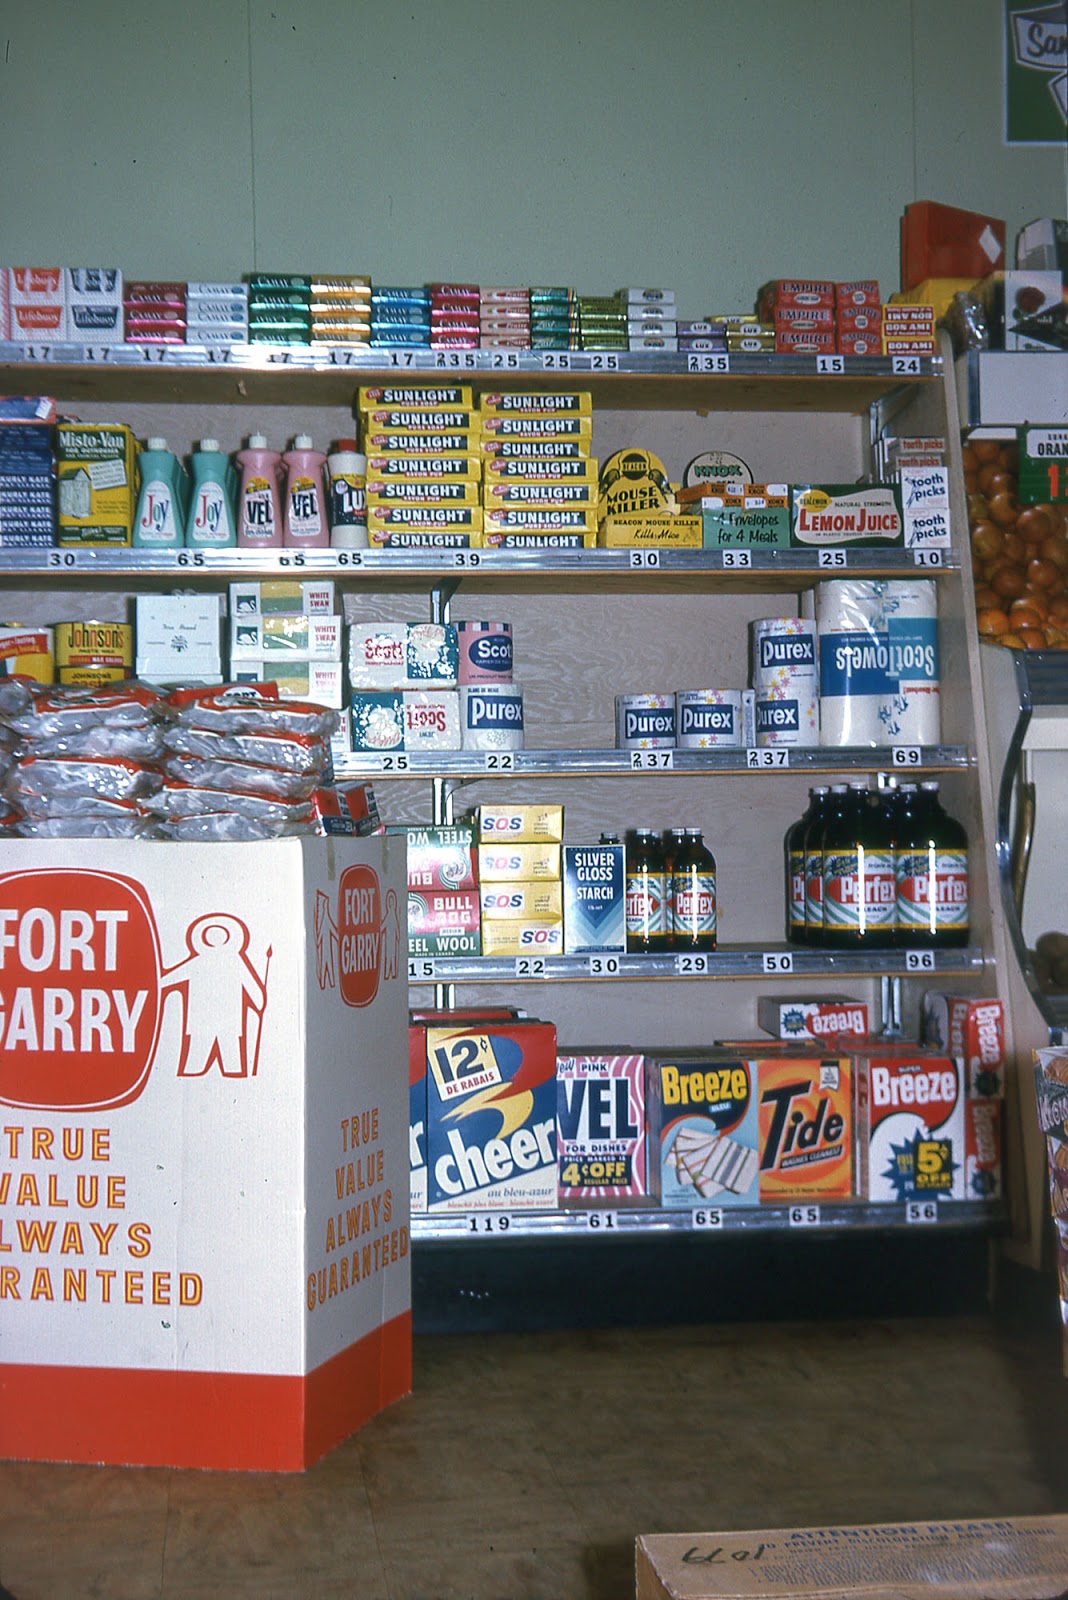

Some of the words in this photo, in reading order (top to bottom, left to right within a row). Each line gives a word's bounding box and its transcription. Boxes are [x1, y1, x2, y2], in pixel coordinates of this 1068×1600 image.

[783, 283, 830, 293] EMPIRE
[778, 308, 830, 320] EMPIRE
[886, 323, 907, 331] BON
[909, 323, 931, 331] AMI
[781, 331, 832, 344] EMPIRE
[27, 345, 50, 360] 17
[888, 342, 909, 350] BON
[912, 342, 933, 350] AMI
[86, 347, 110, 361] 17
[143, 348, 165, 362] 17
[208, 350, 230, 363] 17
[267, 352, 290, 363] 17
[329, 351, 353, 365] 17
[391, 352, 414, 366] 17
[494, 354, 517, 367] 25
[545, 355, 568, 368] 25
[593, 355, 617, 369] 25
[820, 358, 842, 372] 15
[896, 360, 918, 372] 24
[384, 389, 457, 401] SUNLIGHT
[503, 396, 574, 408] SUNLIGHT
[391, 413, 464, 426] SUNLIGHT
[503, 420, 574, 432] SUNLIGHT
[59, 431, 125, 448] Misto-Van
[389, 436, 462, 449] SUNLIGHT
[502, 443, 574, 455] SUNLIGHT
[388, 459, 462, 472] SUNLIGHT
[507, 462, 580, 474] SUNLIGHT
[694, 464, 743, 478] KNOX
[912, 474, 944, 488] tooth
[386, 484, 460, 497] SUNLIGHT
[510, 486, 583, 499] SUNLIGHT
[607, 486, 658, 505] MOUSE
[914, 485, 946, 501] picks
[141, 494, 170, 531] Joy
[246, 498, 273, 525] VEL
[291, 493, 318, 518] VEL
[607, 498, 660, 516] KILLER
[195, 494, 223, 532] Joy
[391, 509, 466, 522] SUNLIGHT
[507, 511, 580, 523] SUNLIGHT
[729, 512, 779, 528] Envelopes
[673, 519, 699, 527] KILLER
[913, 514, 945, 528] tooth
[391, 534, 464, 547] SUNLIGHT
[658, 527, 680, 540] Mice
[718, 528, 733, 544] for
[736, 530, 745, 541] 4
[749, 529, 778, 544] Meals
[916, 526, 947, 542] picks
[506, 535, 578, 548] SUNLIGHT
[50, 554, 75, 566] 30
[178, 553, 204, 567] 65
[279, 554, 305, 567] 65
[338, 552, 362, 566] 65
[455, 553, 480, 566] 39
[632, 553, 658, 566] 30
[724, 553, 749, 566] 33
[822, 553, 845, 565] 25
[918, 552, 939, 565] 10
[68, 622, 124, 649] Johnson's
[315, 634, 336, 642] SWAN
[763, 640, 813, 666] Purex
[471, 697, 523, 726] Purex
[627, 712, 673, 737] Purex
[683, 708, 732, 733] Purex
[382, 757, 408, 770] 25
[487, 756, 512, 769] 22
[895, 750, 919, 764] 69
[575, 853, 615, 867] SILVER
[577, 867, 613, 881] GLOSS
[577, 886, 613, 900] STARCH
[344, 887, 376, 927] FORT
[433, 896, 473, 911] BULL
[436, 937, 477, 951] WOOL
[340, 932, 380, 976] GARRY
[909, 954, 932, 967] 96
[408, 963, 433, 977] 15
[519, 961, 544, 974] 22
[592, 959, 617, 972] 30
[681, 958, 705, 972] 29
[766, 956, 791, 970] 50
[812, 1009, 865, 1035] Breeze
[976, 1006, 1001, 1065] Breeze
[446, 1083, 460, 1096] DE
[460, 1071, 495, 1092] RABAIS
[660, 1065, 748, 1106] Breeze
[871, 1067, 957, 1106] Breeze
[557, 1078, 638, 1141] VEL
[340, 1107, 379, 1153] TRUE
[759, 1080, 844, 1172] Tide
[4, 1126, 112, 1162] TRUE
[566, 1144, 587, 1153] FOR
[591, 1143, 627, 1153] DISHES
[435, 1118, 555, 1195] cheer
[335, 1149, 385, 1200] VALUE
[589, 1163, 626, 1178] OFF
[487, 1189, 502, 1198] au
[503, 1187, 554, 1198] bleu-azur
[695, 1212, 720, 1225] 65
[792, 1209, 817, 1222] 65
[909, 1205, 934, 1219] 56
[326, 1187, 393, 1254] ALWAYS
[470, 1218, 510, 1231] 119
[590, 1214, 614, 1228] 61
[307, 1224, 408, 1312] GUARANTEED
[790, 1526, 918, 1541] ATTENTION
[927, 1521, 1013, 1534] PLEASE!
